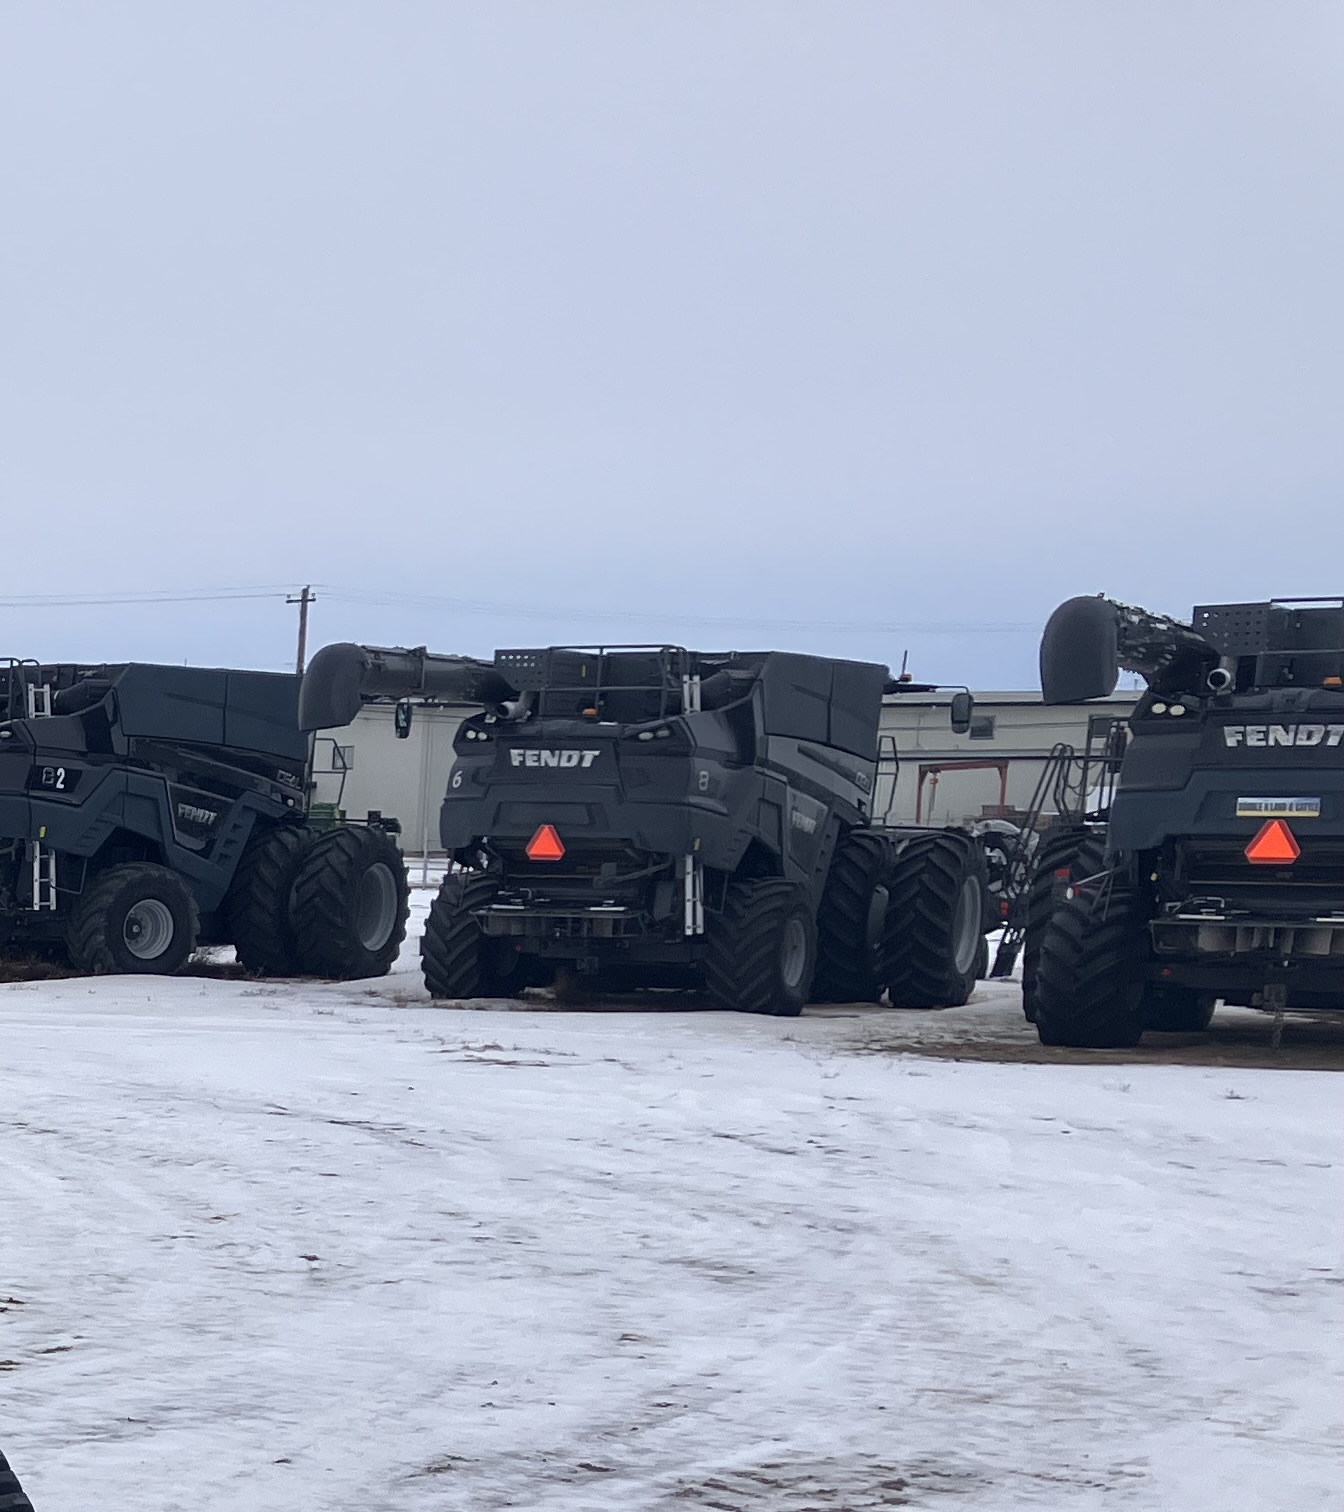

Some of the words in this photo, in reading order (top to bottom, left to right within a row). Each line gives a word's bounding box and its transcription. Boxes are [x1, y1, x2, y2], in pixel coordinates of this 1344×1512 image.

[1223, 724, 1344, 747] FENDT
[510, 749, 601, 768] FENDT
[452, 770, 463, 788] 6
[698, 770, 710, 791] 8
